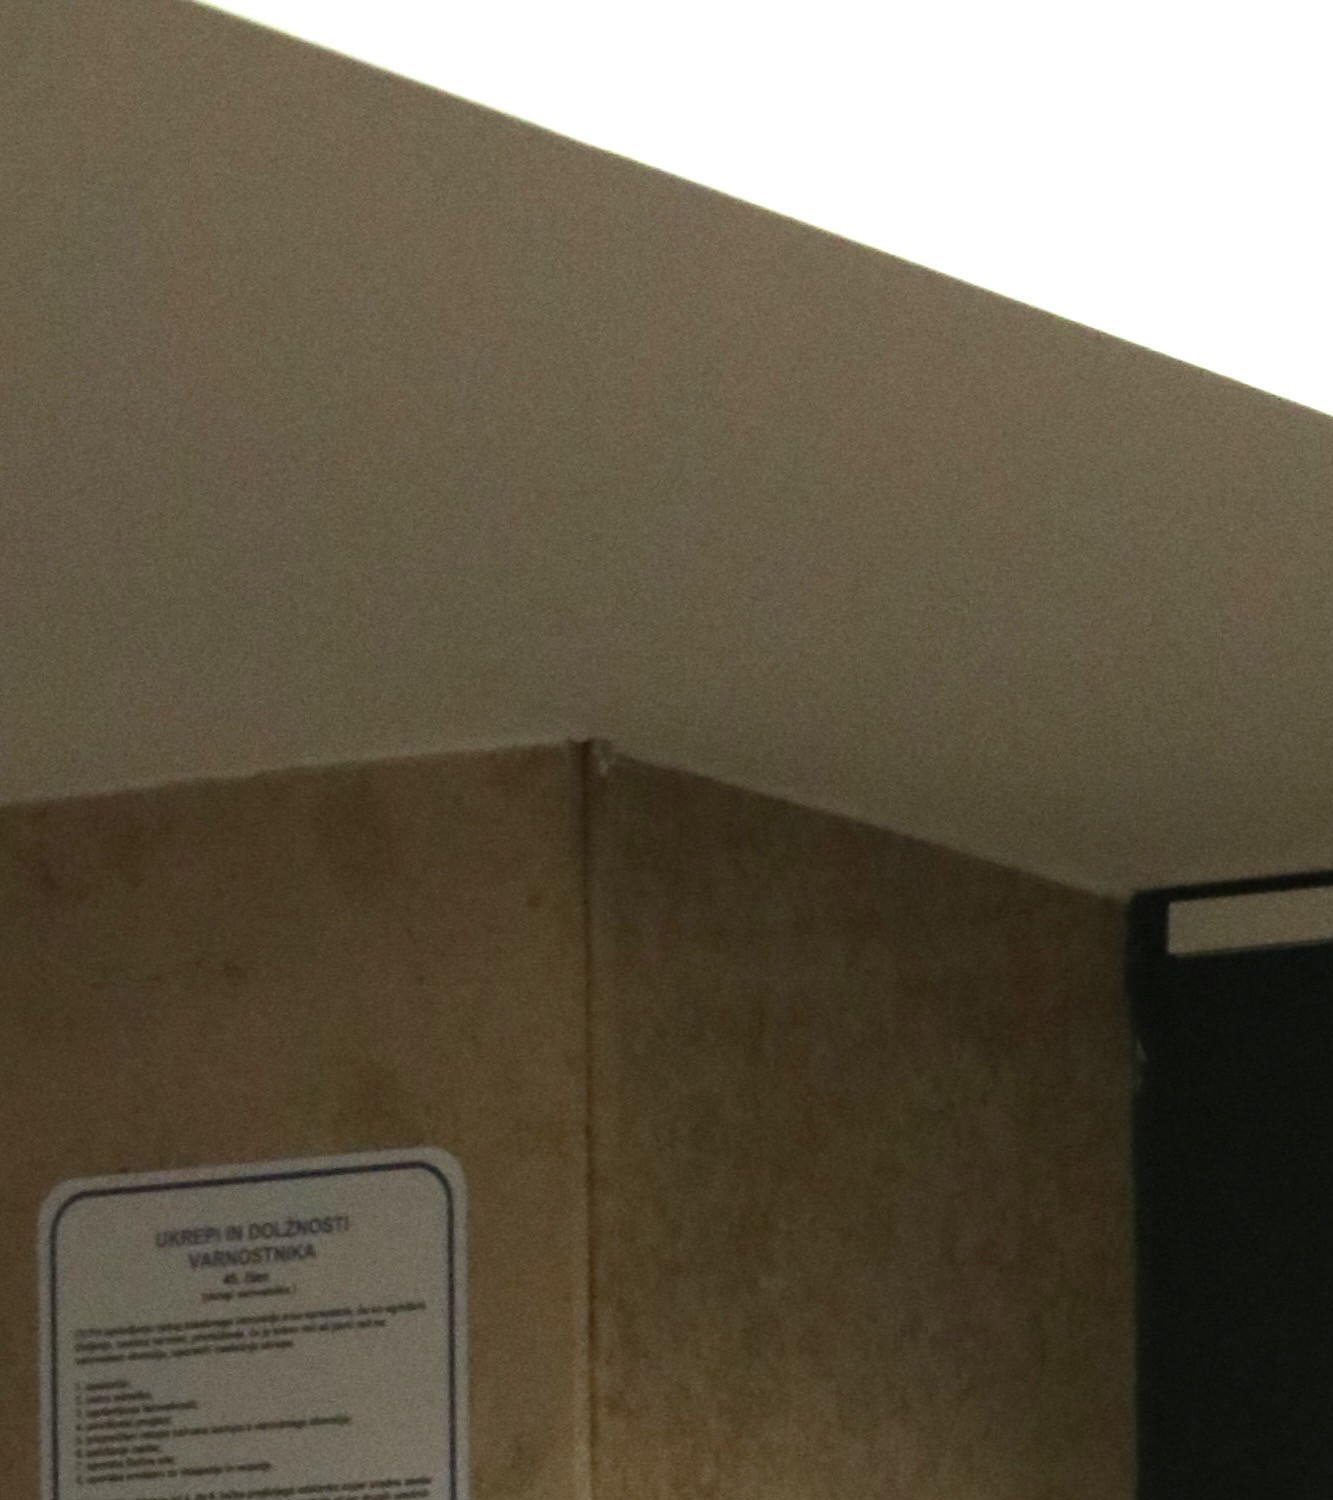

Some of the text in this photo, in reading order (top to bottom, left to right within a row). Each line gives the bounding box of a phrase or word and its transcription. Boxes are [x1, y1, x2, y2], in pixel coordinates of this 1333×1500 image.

[154, 1225, 222, 1249] UKREPI
[224, 1224, 243, 1242] IN
[188, 1243, 317, 1270] VARNOSTNIKA
